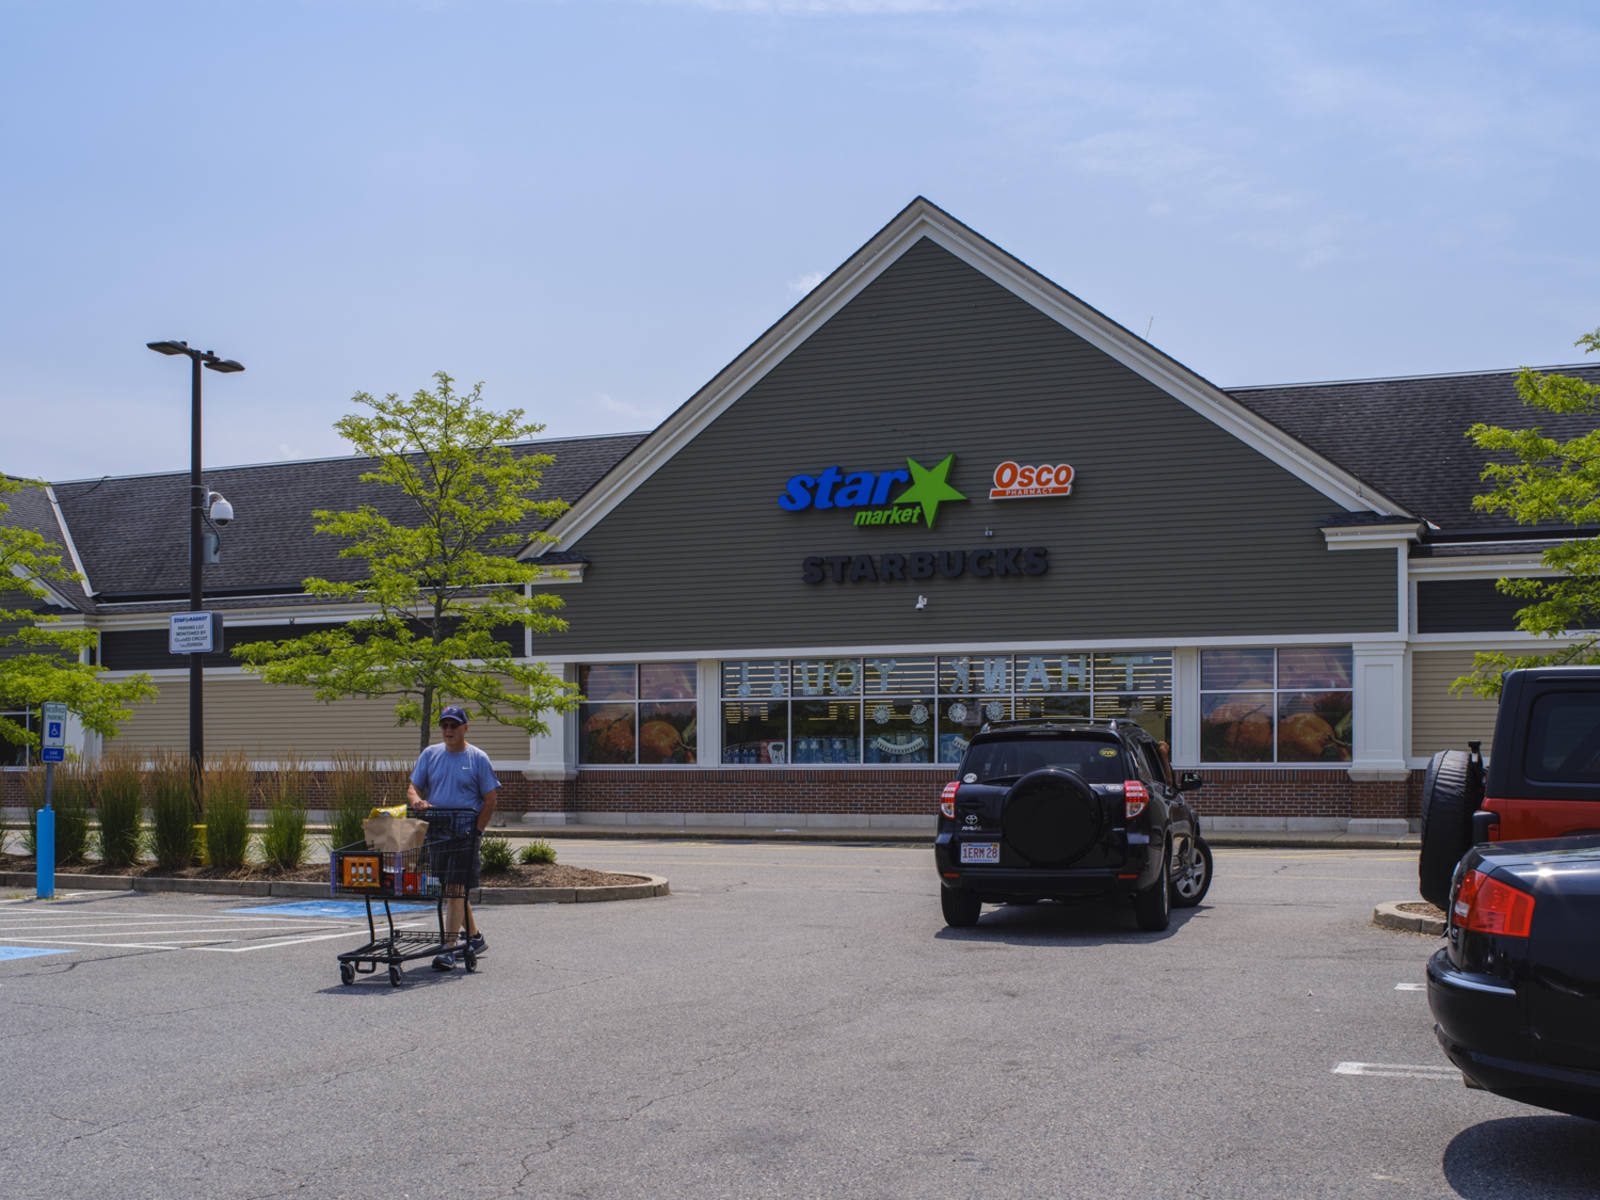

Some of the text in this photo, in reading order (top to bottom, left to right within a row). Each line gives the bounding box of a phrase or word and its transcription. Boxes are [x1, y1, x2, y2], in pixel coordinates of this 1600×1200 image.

[777, 465, 909, 511] star
[1006, 487, 1054, 497] PHARMACY
[853, 506, 921, 526] market
[801, 546, 1049, 585] STARBUCKS
